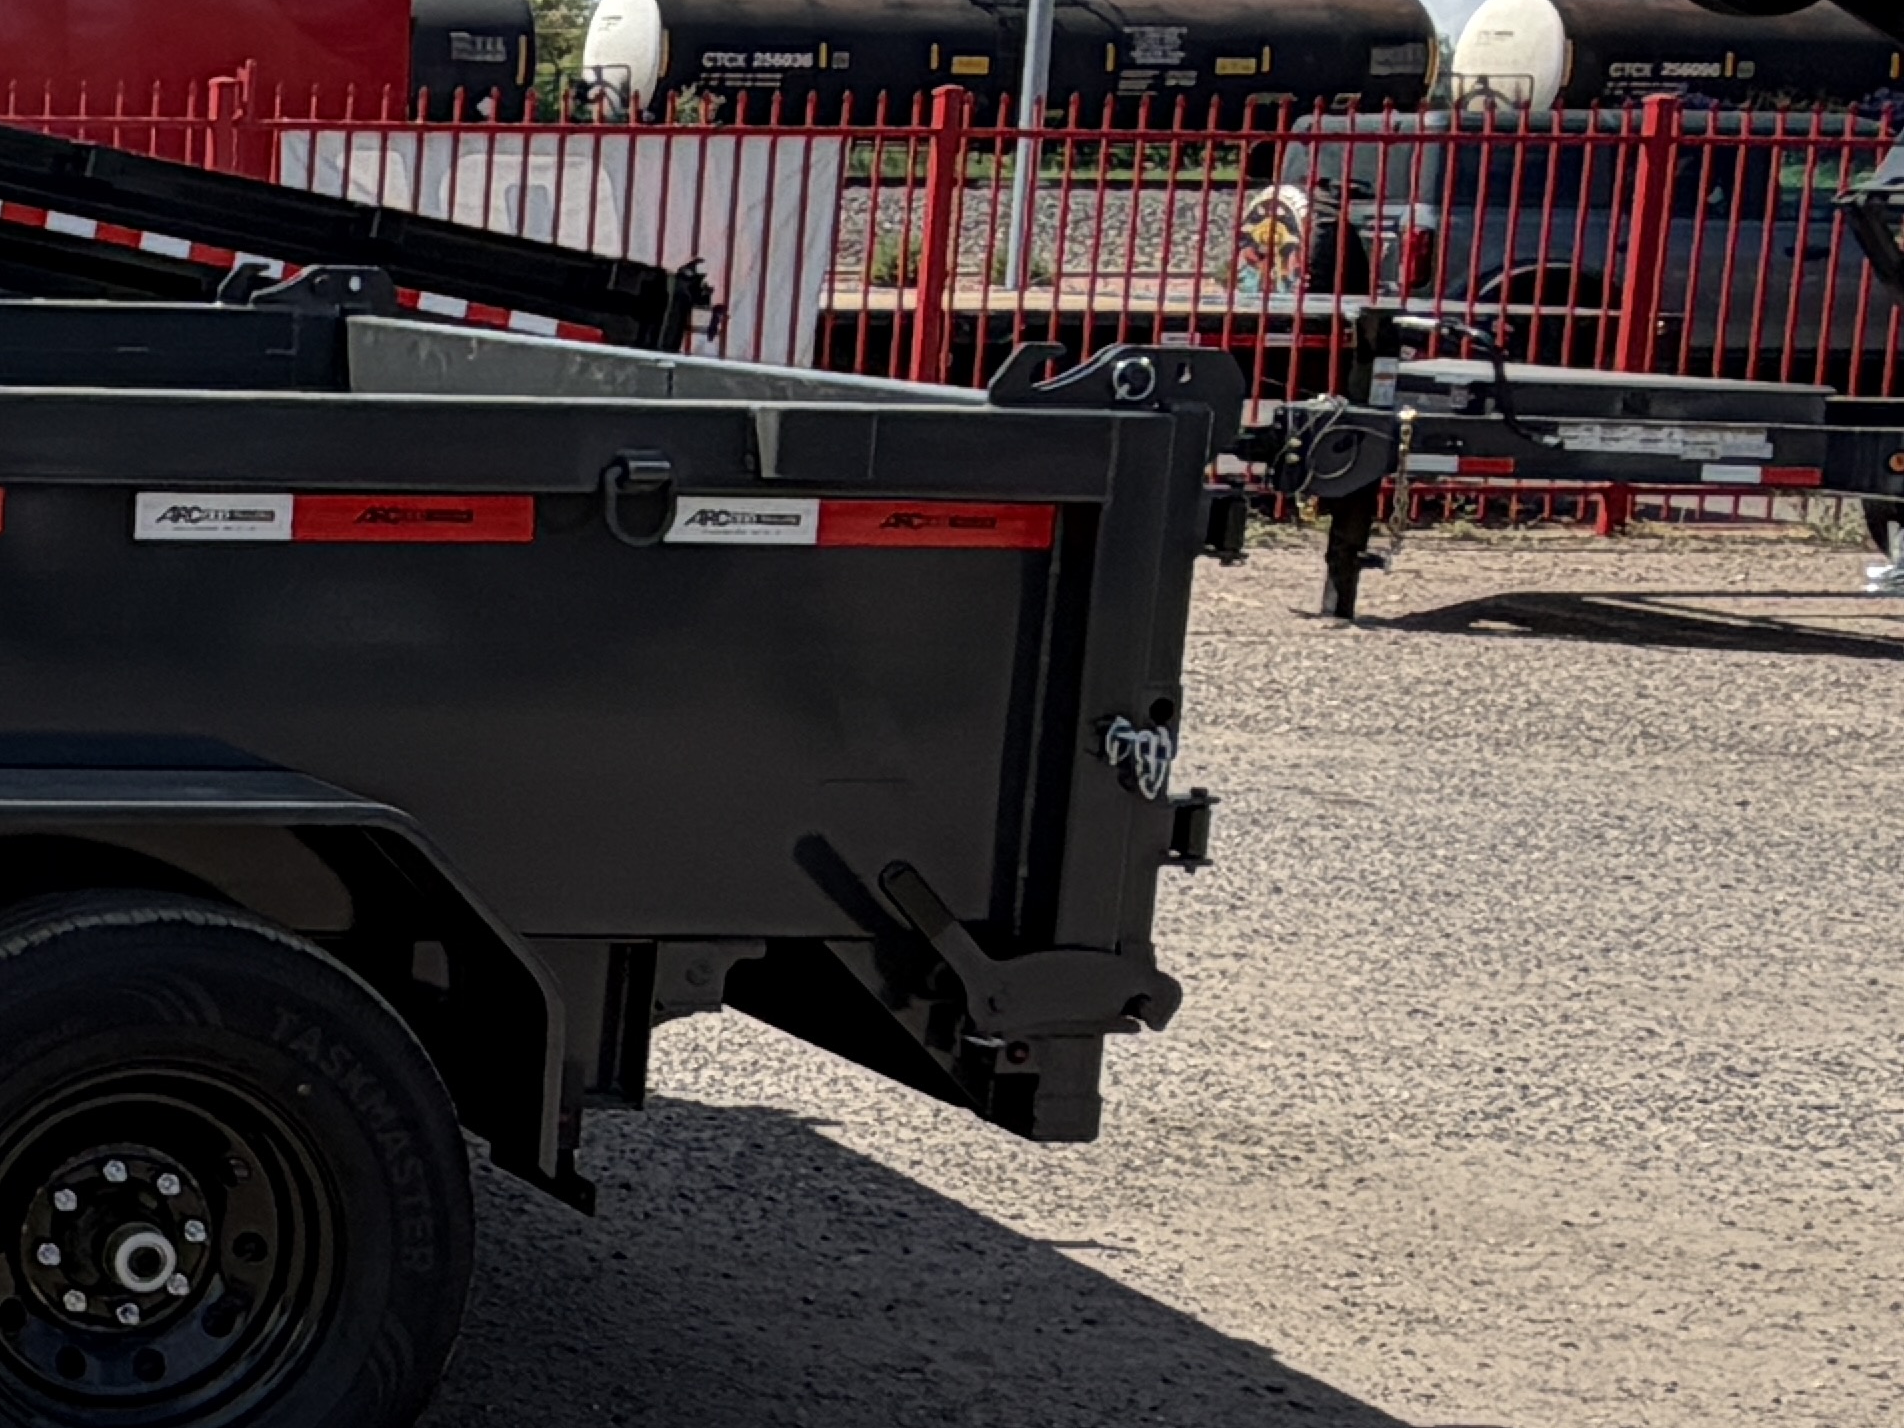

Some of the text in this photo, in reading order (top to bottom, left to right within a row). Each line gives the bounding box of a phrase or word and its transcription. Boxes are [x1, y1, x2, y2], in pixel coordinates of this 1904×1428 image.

[155, 505, 203, 524] ARC
[684, 508, 732, 527] ARC
[271, 1006, 434, 1273] TASKMASTER
